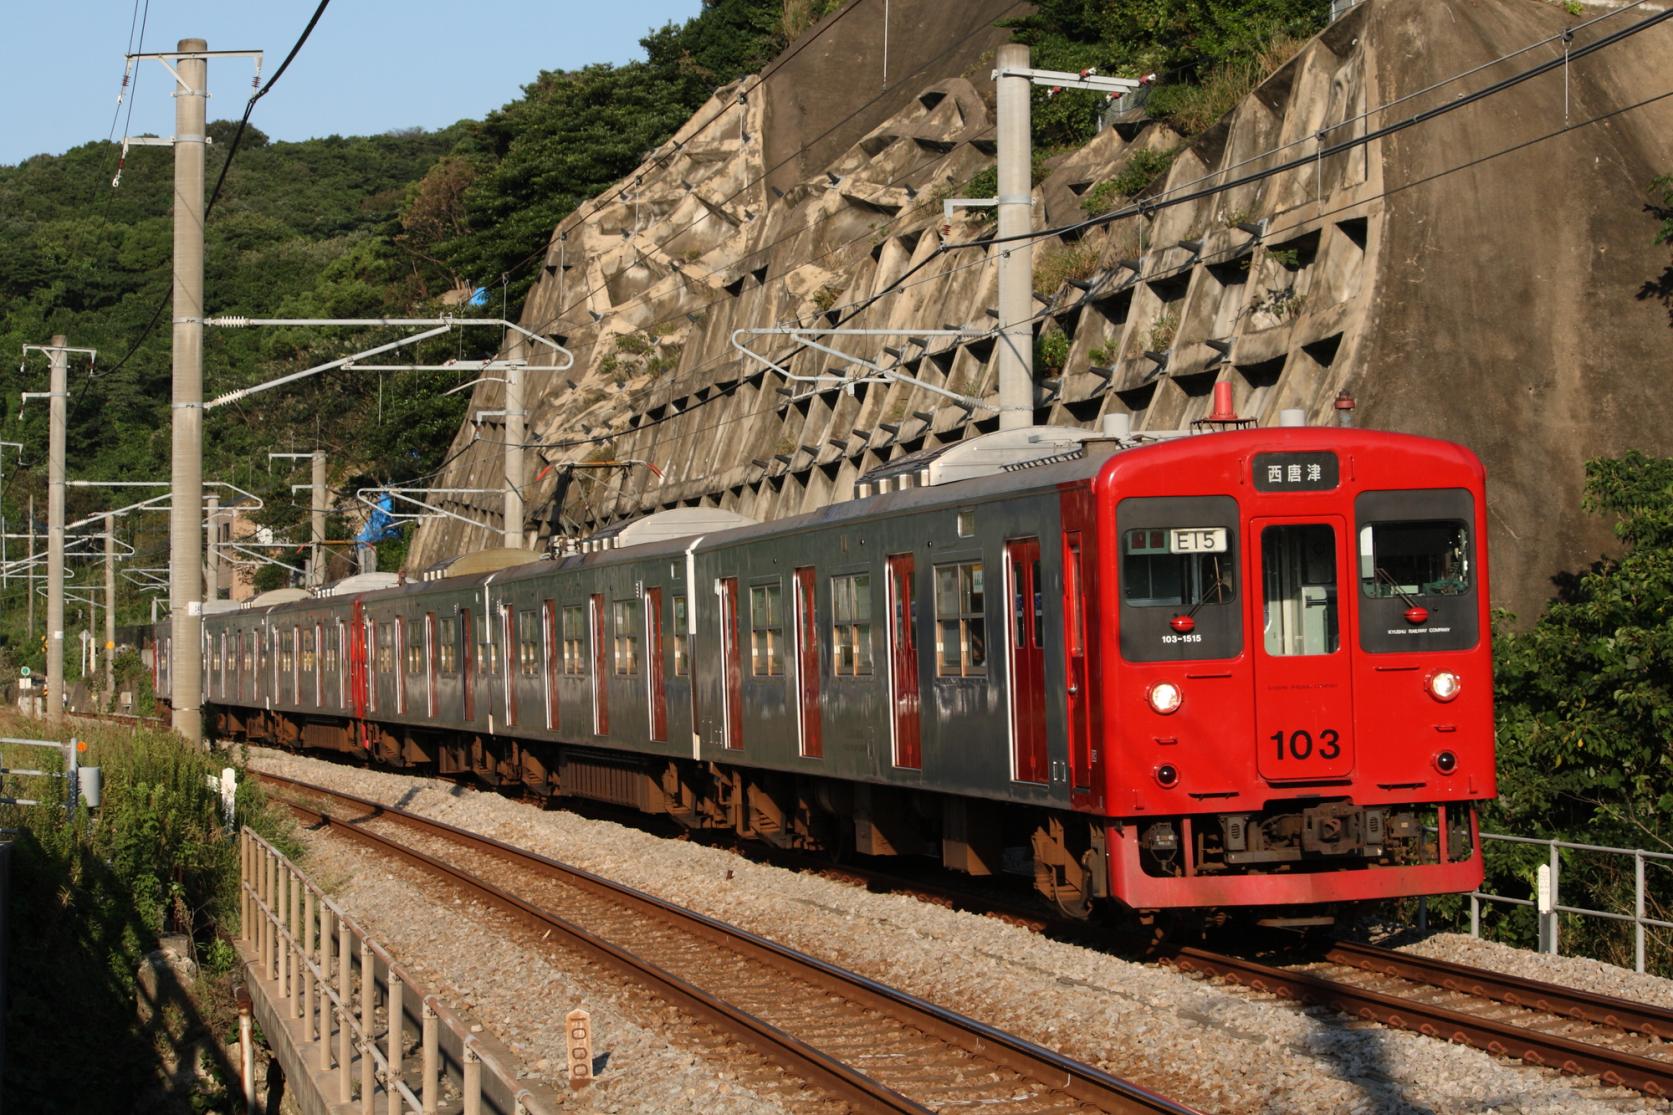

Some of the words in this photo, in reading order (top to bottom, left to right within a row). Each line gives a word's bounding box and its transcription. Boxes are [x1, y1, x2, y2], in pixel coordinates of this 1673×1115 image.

[1267, 464, 1321, 483] 西唐津
[1177, 531, 1215, 549] E15
[1161, 634, 1202, 644] 103-1515
[1270, 729, 1341, 760] 103
